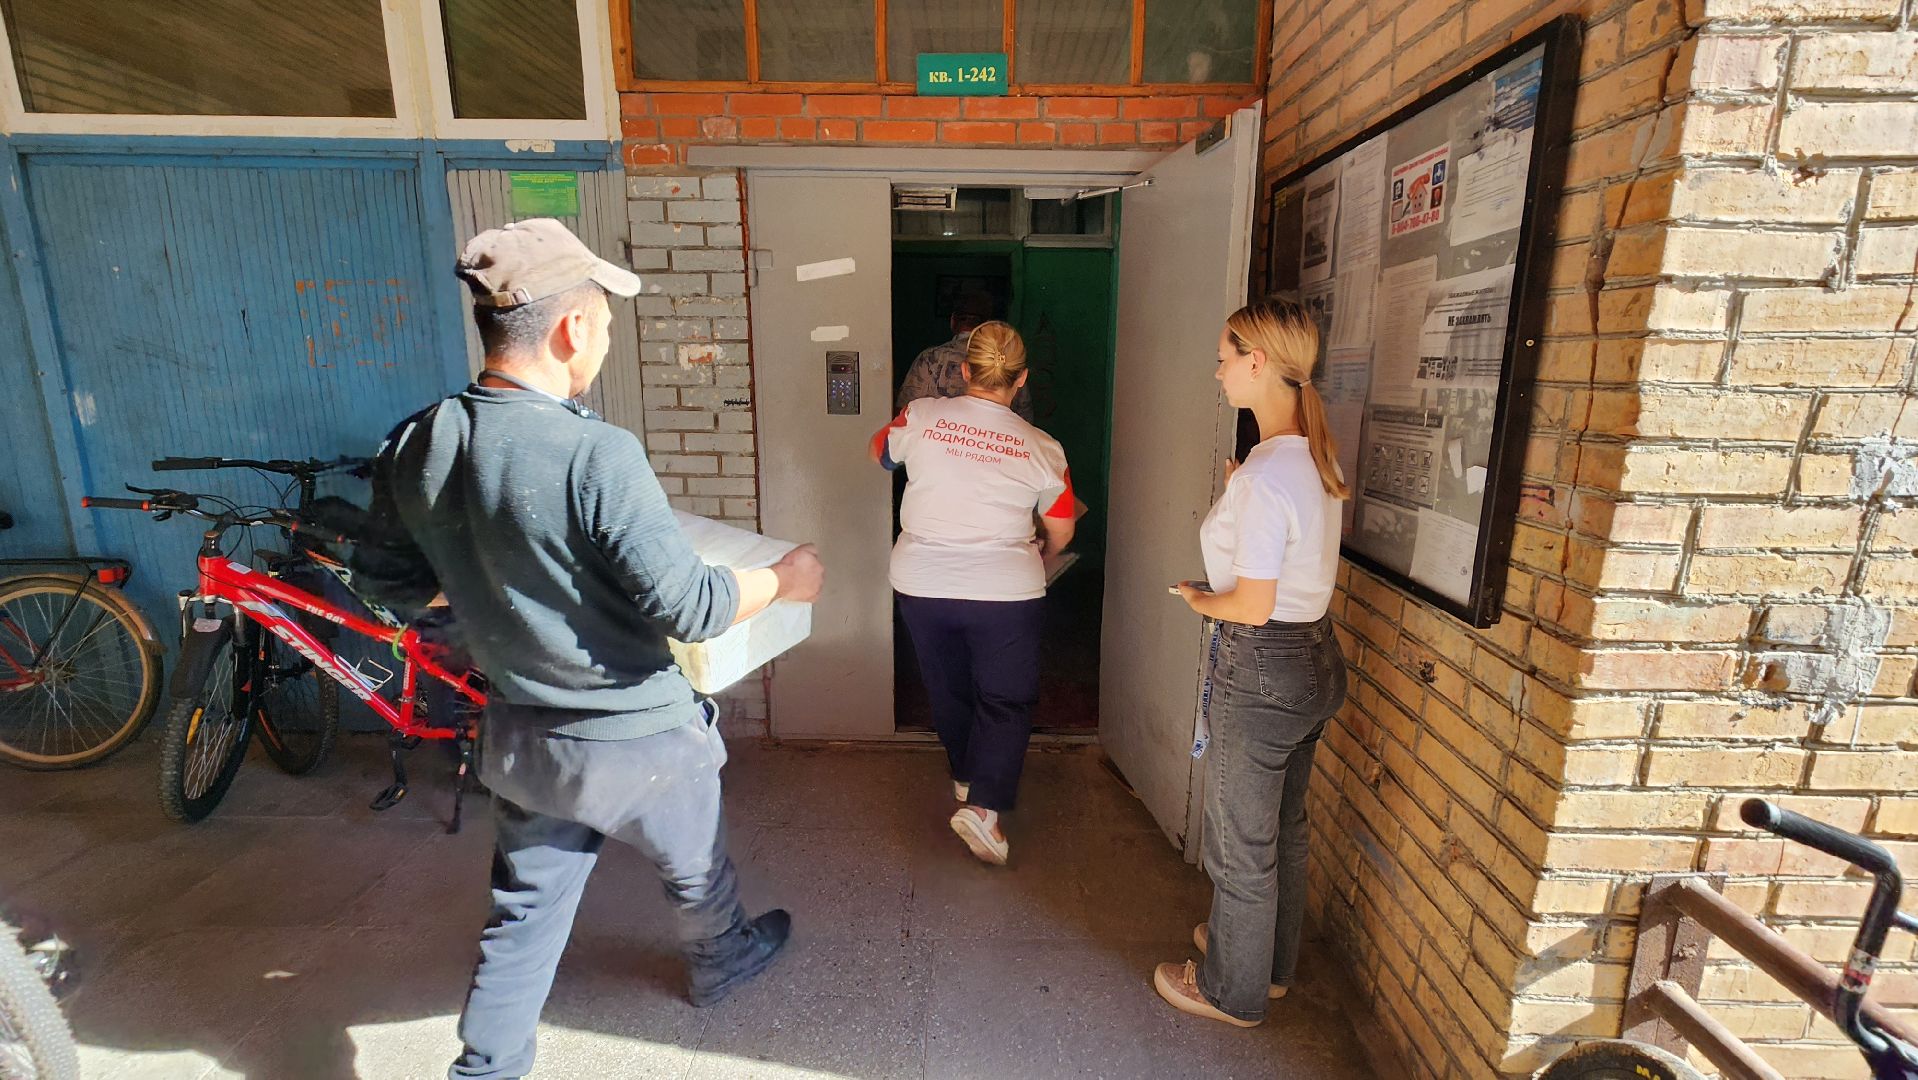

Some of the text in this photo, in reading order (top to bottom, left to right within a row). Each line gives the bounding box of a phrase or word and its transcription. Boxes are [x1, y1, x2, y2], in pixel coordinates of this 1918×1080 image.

[928, 66, 996, 83] кв. 1-242
[922, 429, 1031, 461] ПОДМОСКОВЬЯ
[935, 418, 1025, 447] ВОЛОНТЕРЫ
[945, 447, 1002, 465] МЫ РЯДОМ
[269, 624, 372, 701] STINGER
